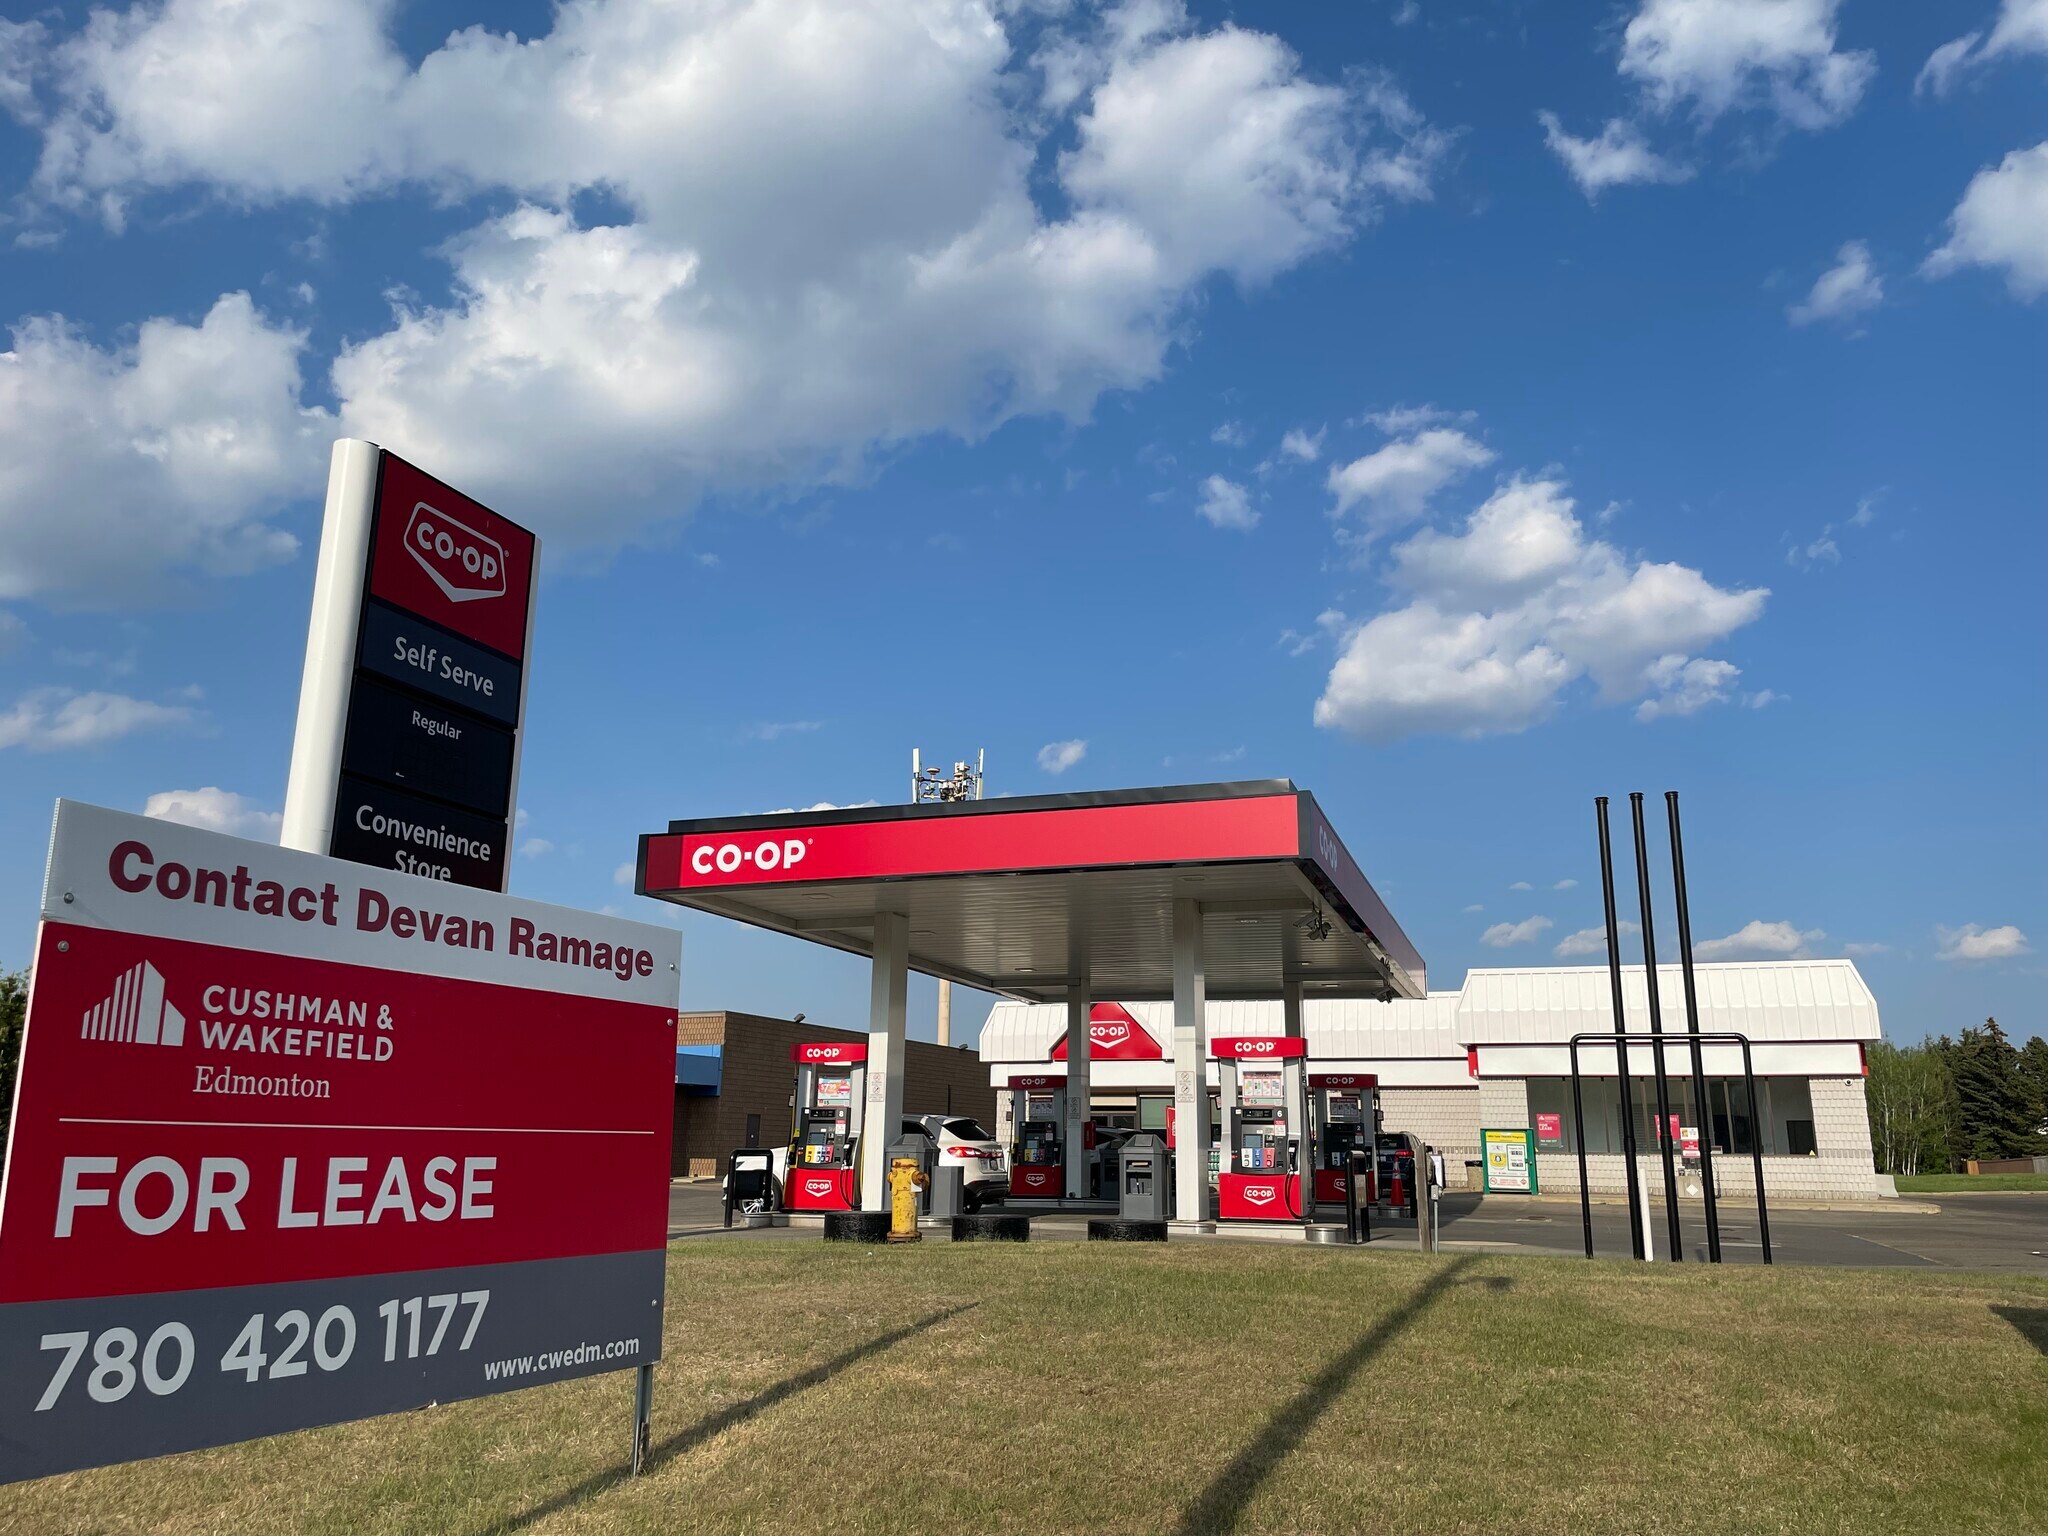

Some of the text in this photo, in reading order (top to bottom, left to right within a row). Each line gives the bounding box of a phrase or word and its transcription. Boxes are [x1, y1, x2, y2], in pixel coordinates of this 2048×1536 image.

[394, 636, 494, 697] Self Serve
[412, 710, 462, 741] Regular
[356, 804, 491, 862] Convenience
[394, 850, 452, 883] Store
[692, 839, 806, 875] CO-OP
[108, 840, 655, 982] Contact Devan Ramage
[202, 984, 395, 1031] CUSHMAN &
[200, 1020, 394, 1062] WAKEFIELD
[192, 1065, 331, 1099] Edmonton
[838, 1110, 844, 1118] 8
[1277, 1110, 1283, 1118] 6
[54, 1156, 498, 1238] FOR LEASE
[34, 1289, 490, 1412] 780 420 1177
[484, 1335, 640, 1381] www.cwedm.com
